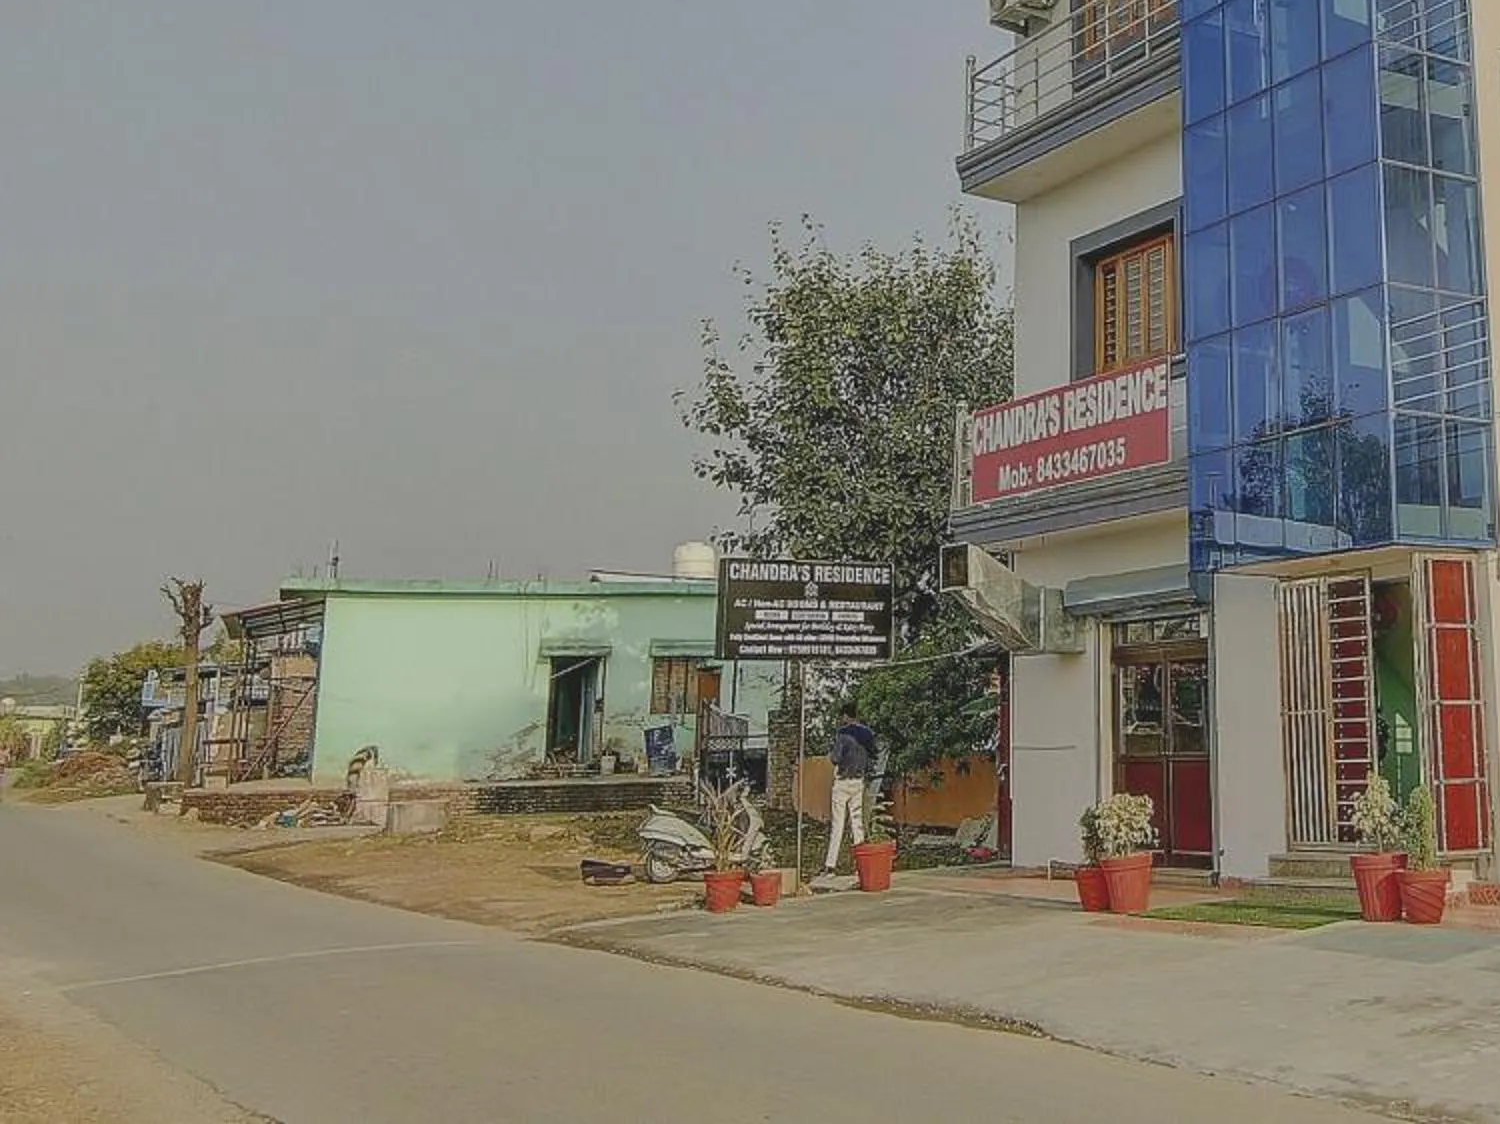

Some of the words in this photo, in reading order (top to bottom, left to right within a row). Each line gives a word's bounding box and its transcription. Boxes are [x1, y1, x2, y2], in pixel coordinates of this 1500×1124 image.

[974, 394, 1060, 456] CHANDRA'S
[1063, 364, 1167, 432] RESIDENCE
[998, 461, 1032, 492] Mob:
[1036, 437, 1126, 483] 8433467035
[729, 563, 811, 580] CHANDRA'S
[815, 565, 891, 584] RESIDENCE
